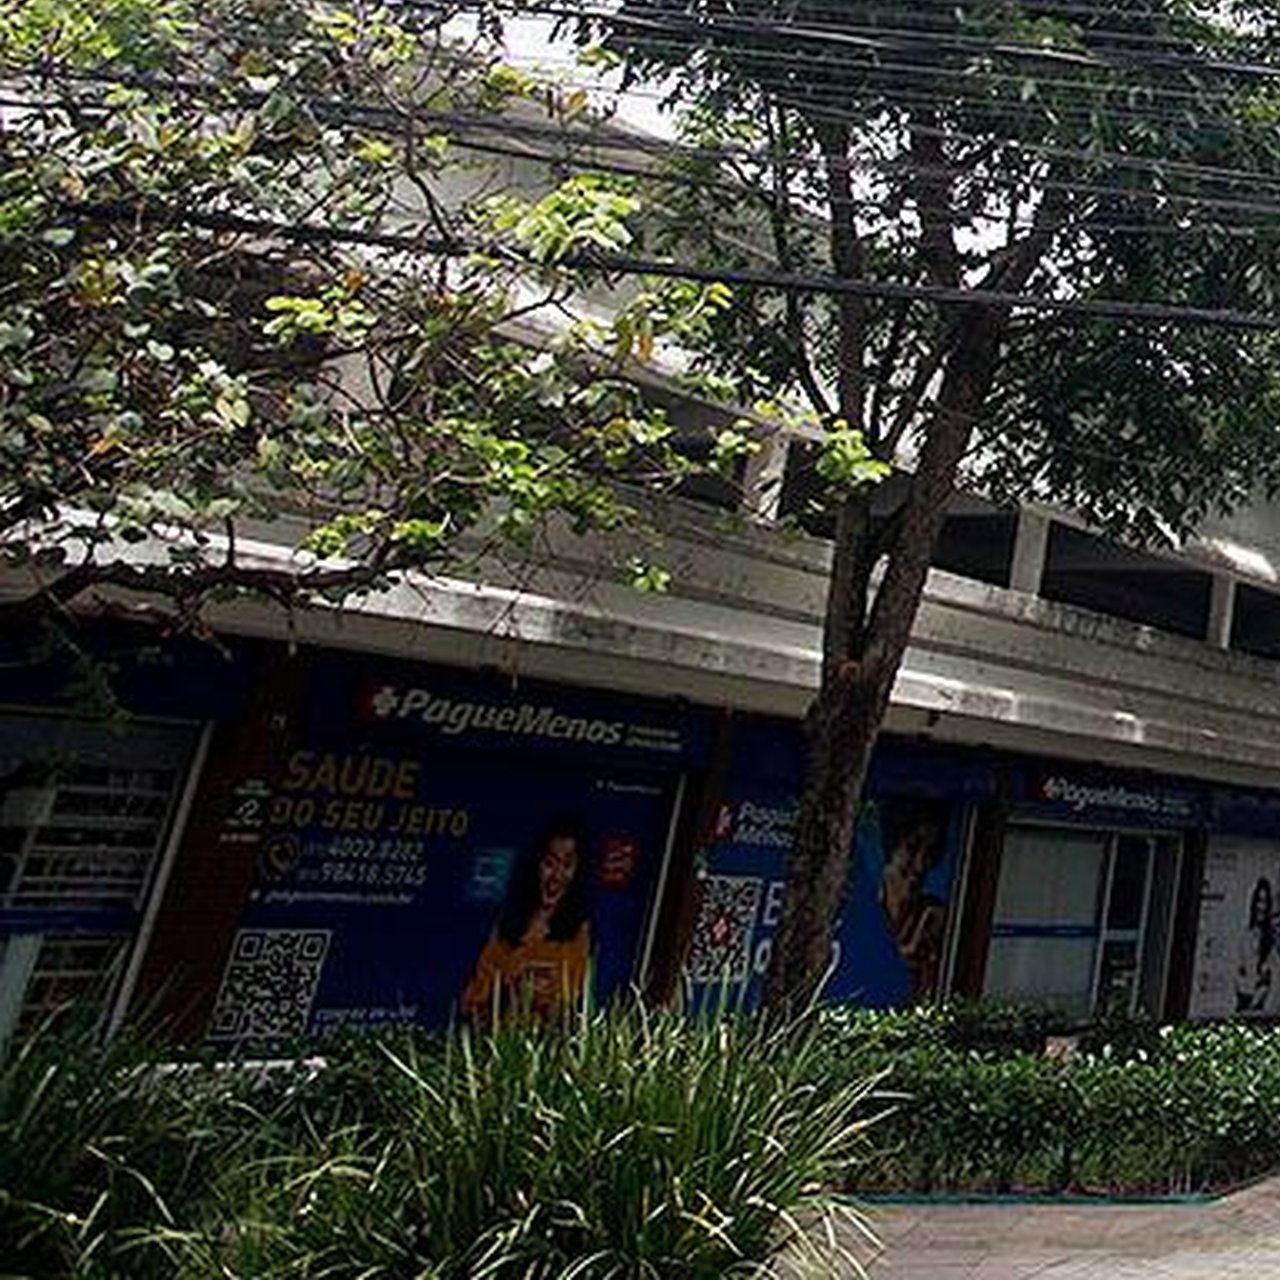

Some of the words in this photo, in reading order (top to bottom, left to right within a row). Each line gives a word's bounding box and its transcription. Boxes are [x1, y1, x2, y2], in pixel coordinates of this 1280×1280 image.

[396, 687, 628, 745] PagueMenos
[320, 800, 386, 832] SEU
[387, 803, 471, 838] JEITO
